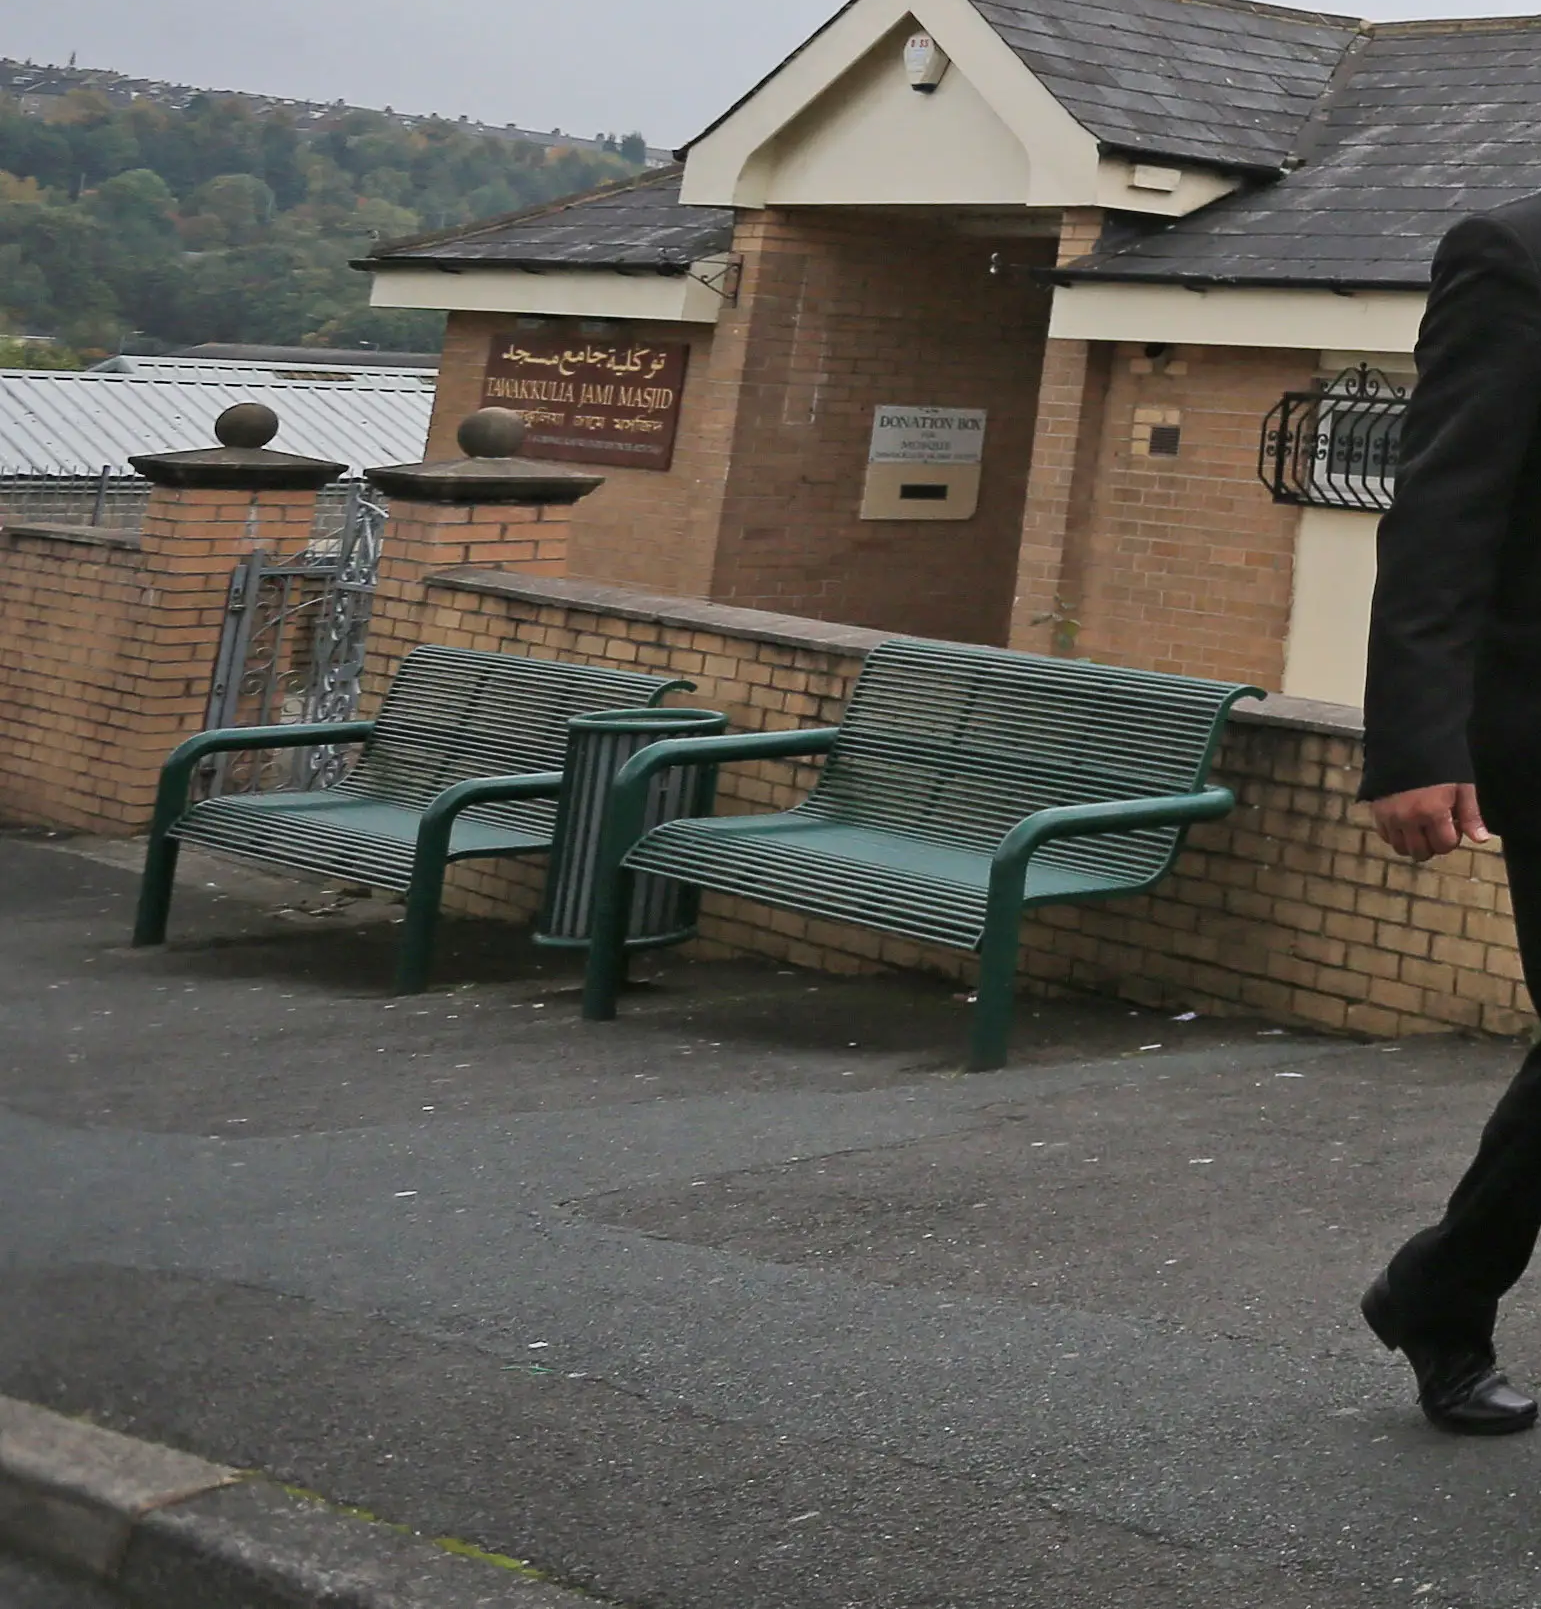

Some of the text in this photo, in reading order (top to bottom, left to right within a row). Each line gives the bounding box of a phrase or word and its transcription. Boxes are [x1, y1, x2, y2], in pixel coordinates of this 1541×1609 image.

[502, 344, 559, 367] مسجد
[559, 345, 608, 376] جامع
[578, 382, 614, 407] JAMI
[617, 386, 674, 412] MASJID
[880, 415, 982, 431] DONATION BOX
